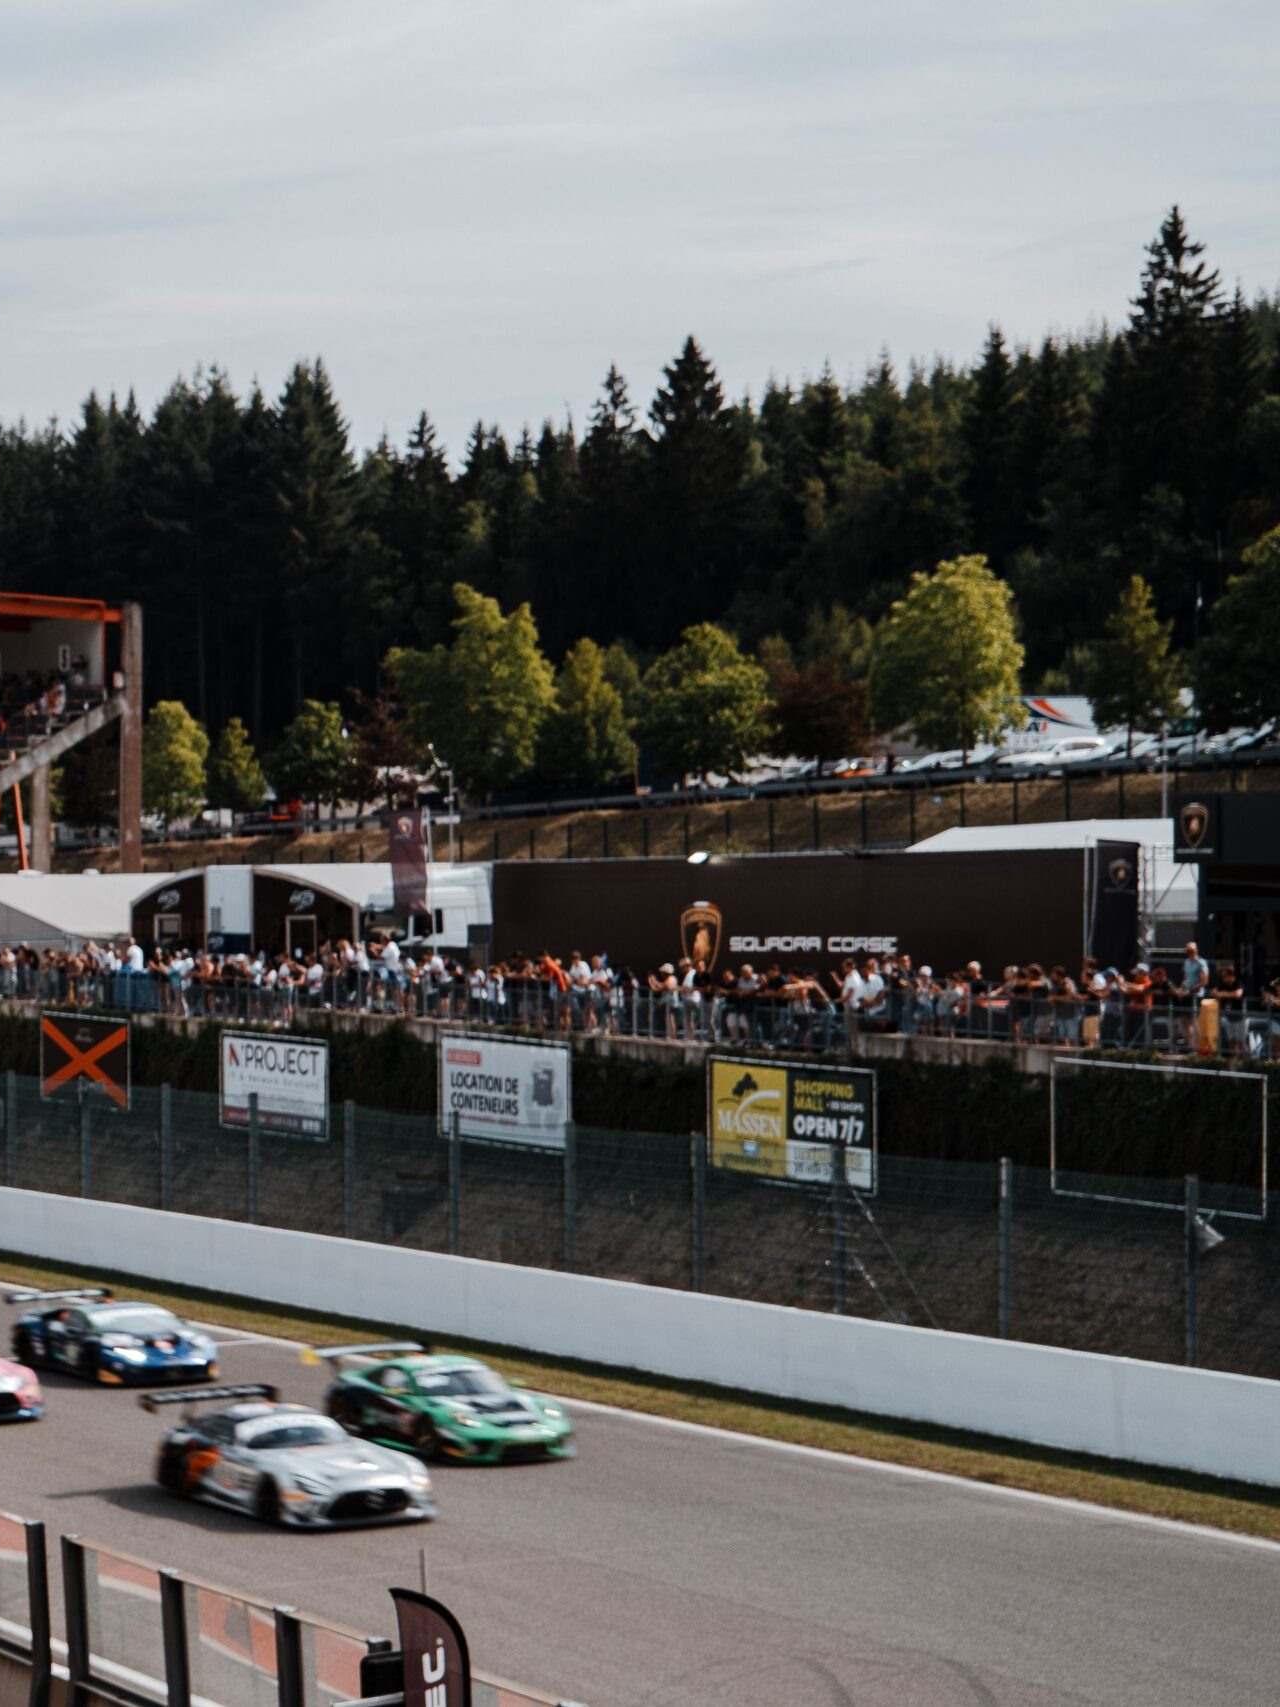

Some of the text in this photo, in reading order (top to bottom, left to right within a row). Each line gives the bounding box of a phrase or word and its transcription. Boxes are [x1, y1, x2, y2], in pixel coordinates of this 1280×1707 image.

[730, 936, 898, 952] SQUADRA CORSE
[450, 1071, 519, 1096] LOCATION DE
[794, 1080, 854, 1100] SHOPPING
[450, 1091, 519, 1116] CONTENEURS
[794, 1096, 824, 1113] MALL
[793, 1114, 865, 1144] OPEN 7/7
